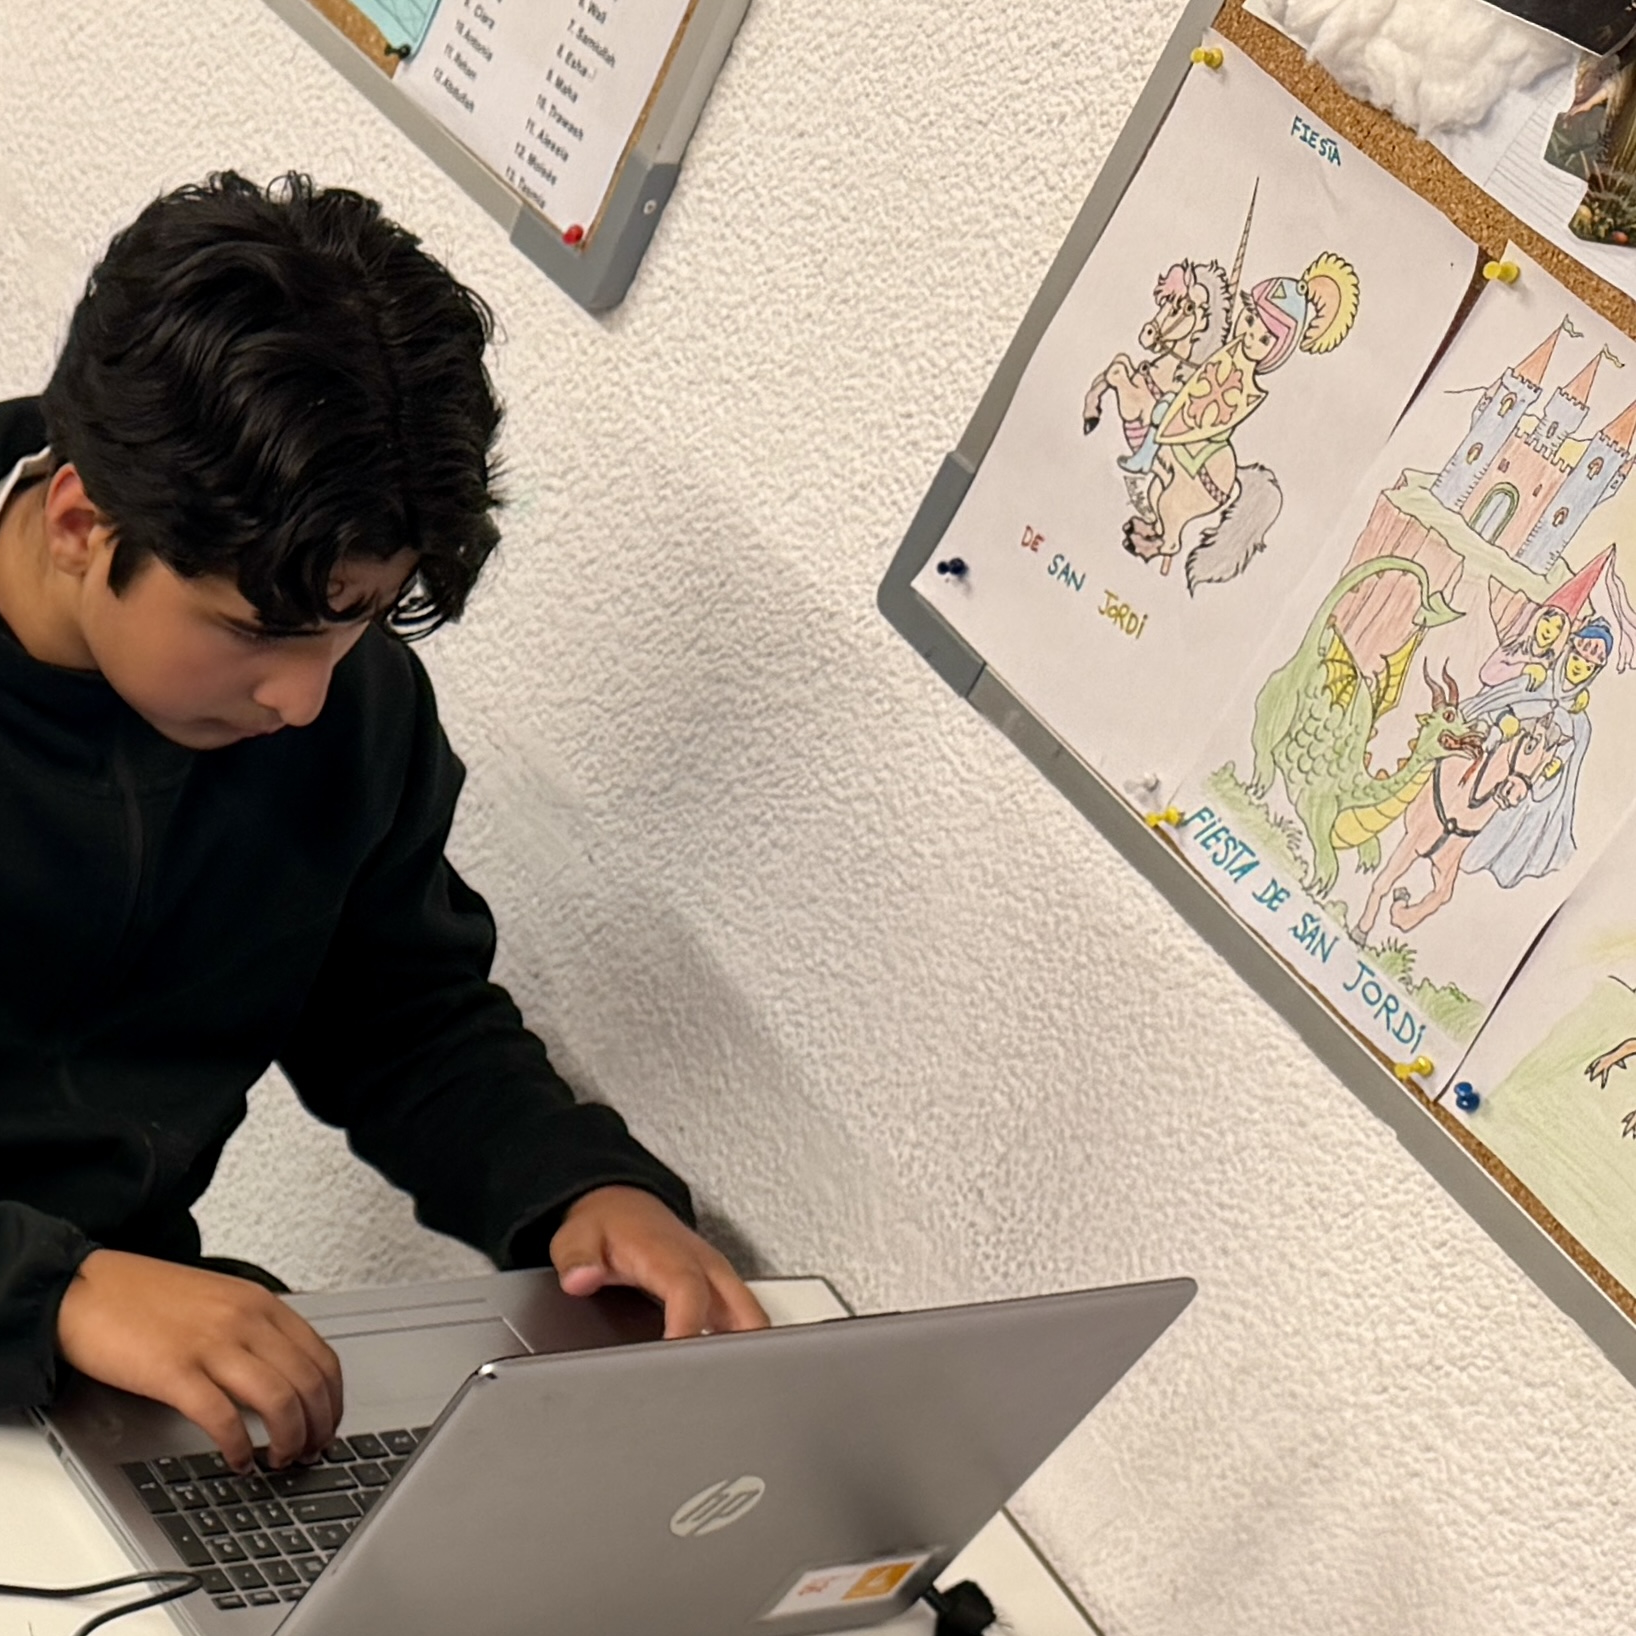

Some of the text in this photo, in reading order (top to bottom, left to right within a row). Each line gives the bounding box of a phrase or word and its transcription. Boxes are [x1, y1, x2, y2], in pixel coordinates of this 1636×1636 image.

[1291, 114, 1342, 167] FIESTA
[1021, 525, 1046, 553] DE
[1047, 553, 1086, 592] SAN
[1252, 877, 1291, 912] DE
[1289, 912, 1340, 964] SAN
